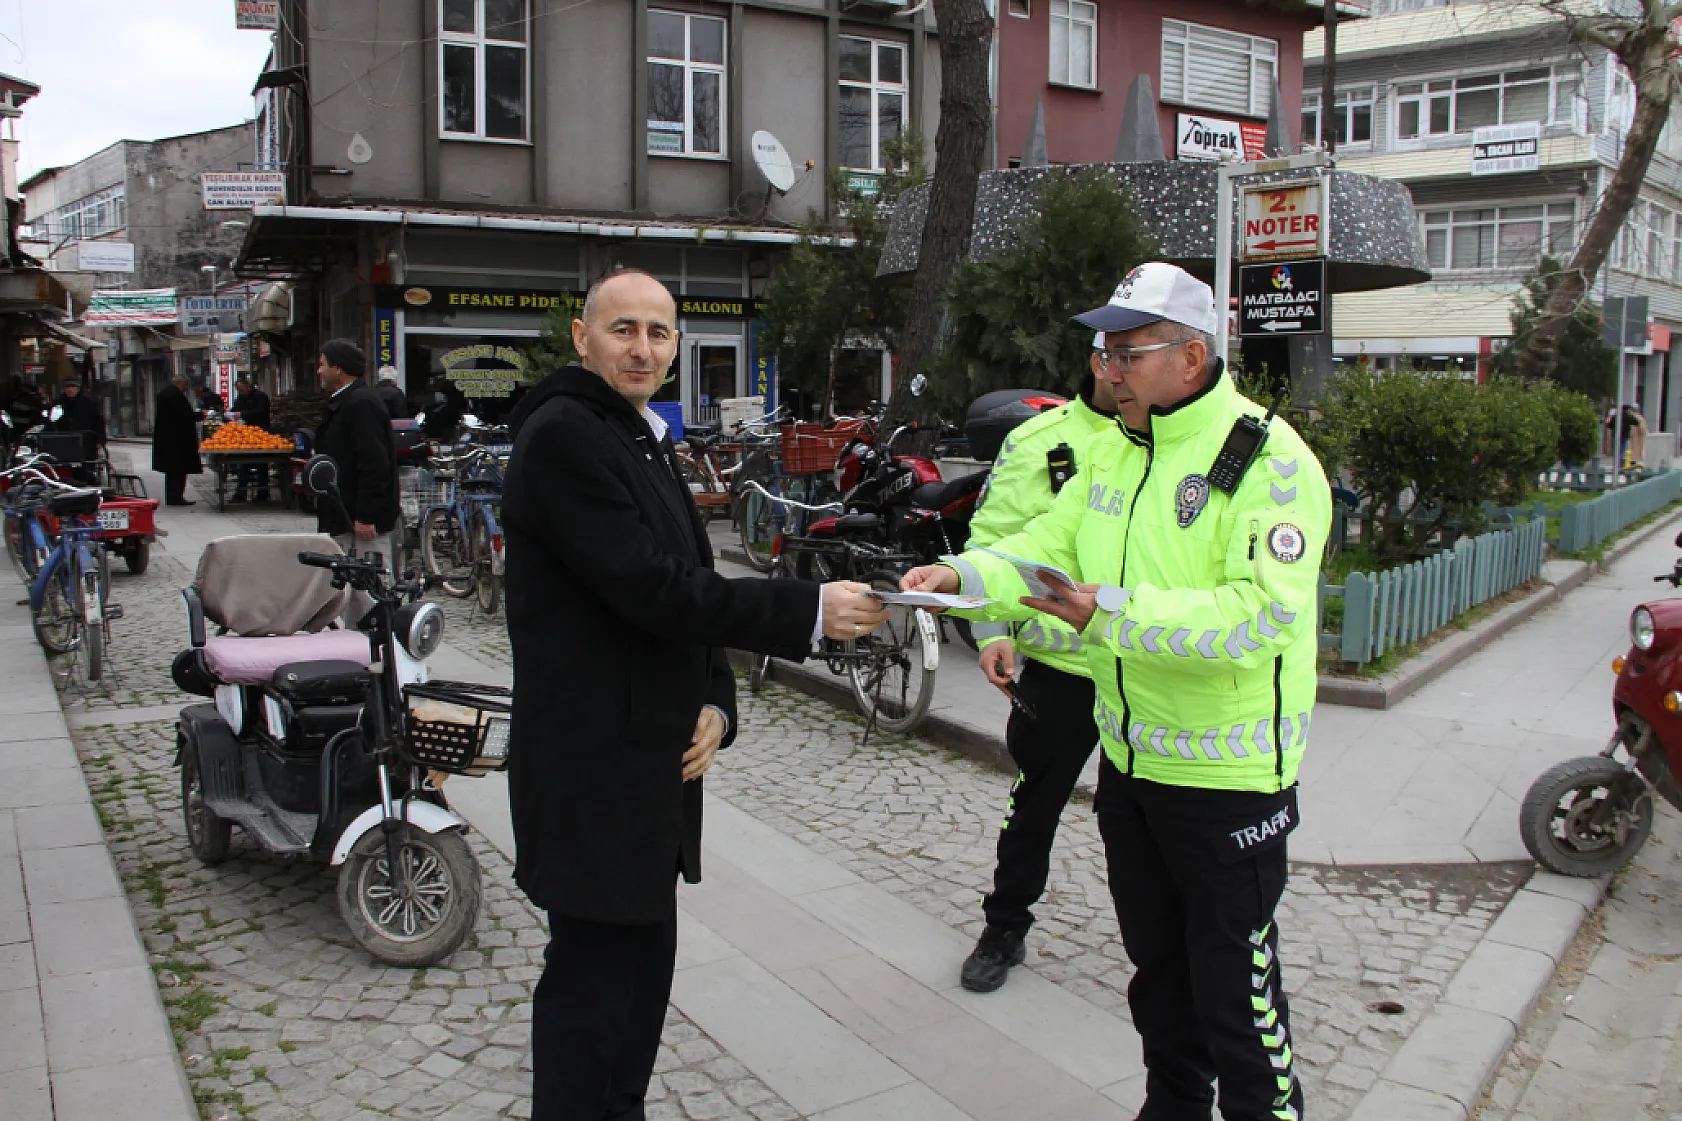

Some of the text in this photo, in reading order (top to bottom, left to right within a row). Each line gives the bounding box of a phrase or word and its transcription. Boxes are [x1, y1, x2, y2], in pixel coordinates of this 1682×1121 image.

[1270, 191, 1296, 213] 2.
[1246, 215, 1320, 237] NOTER
[449, 293, 514, 307] EFSANE
[519, 293, 560, 308] PİDE
[1244, 291, 1320, 306] MATBAACI
[682, 301, 743, 315] SALONU
[1247, 305, 1316, 320] MUSTAFA
[380, 319, 392, 367] EFS
[1088, 484, 1125, 516] OLİS
